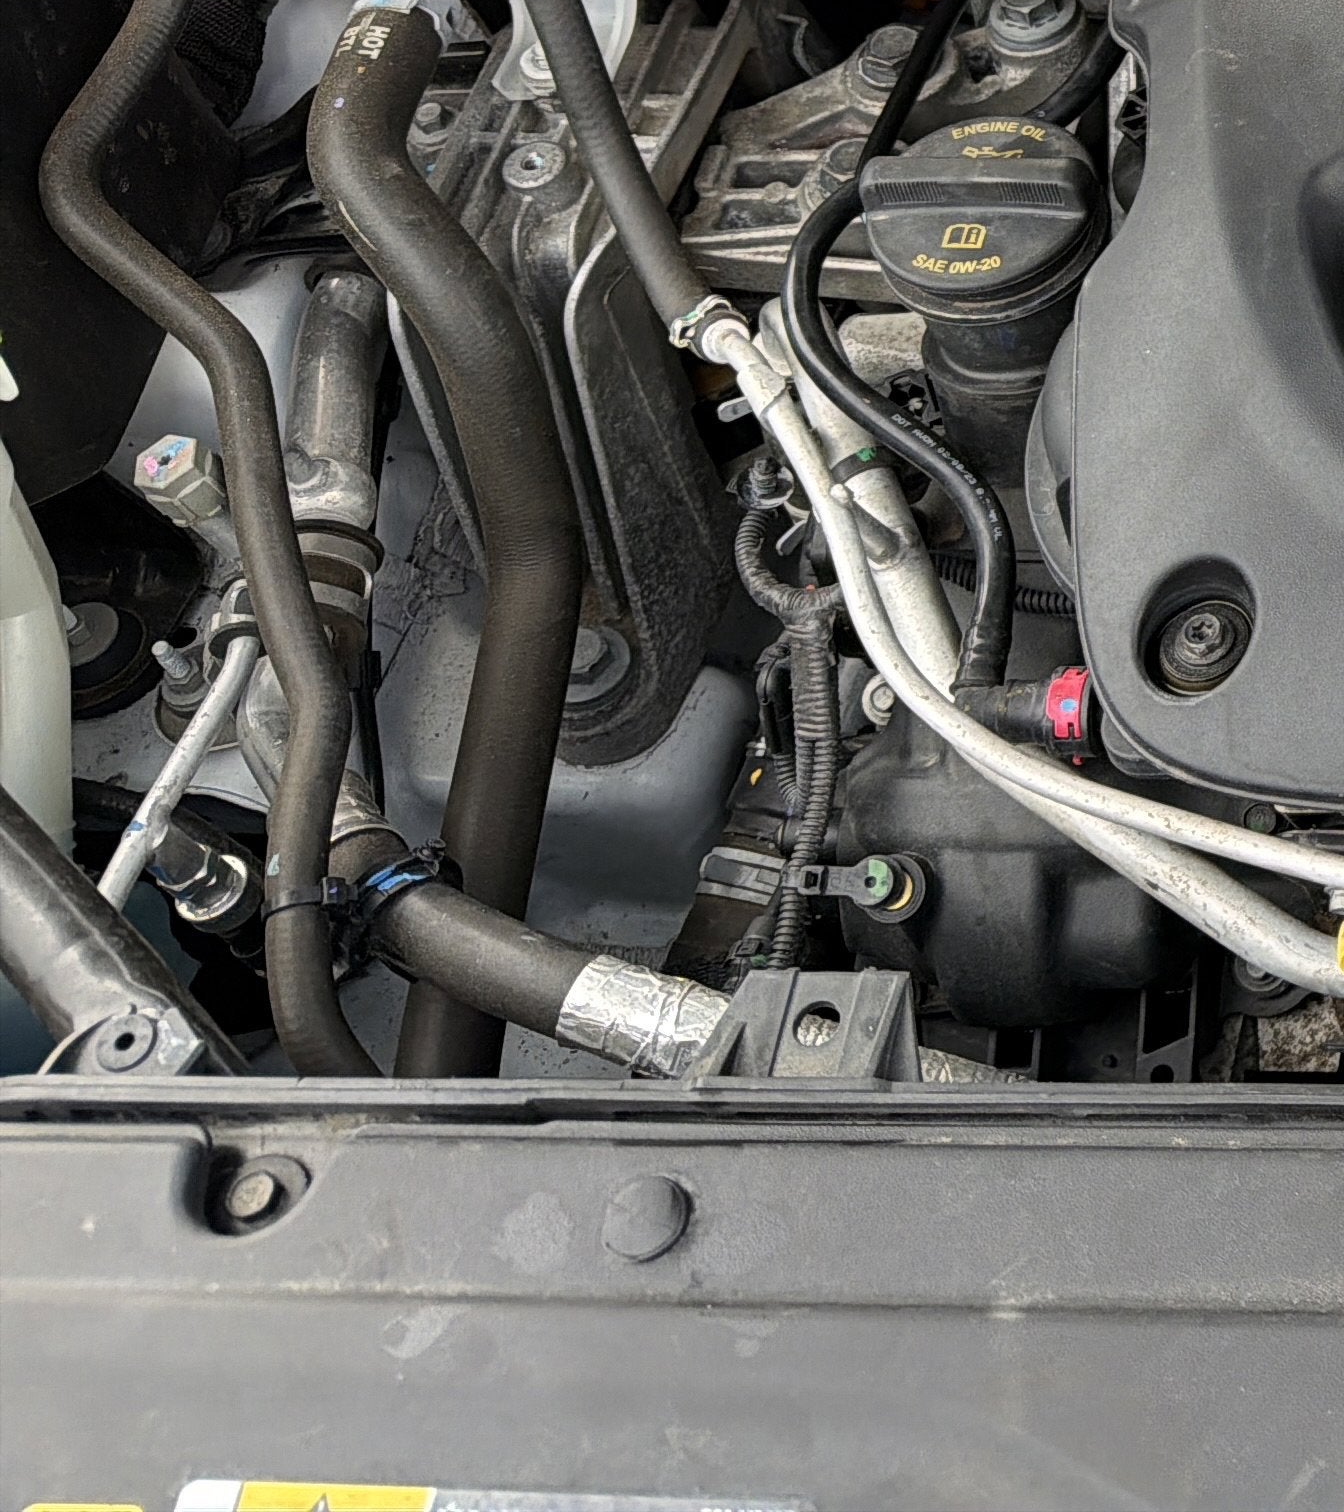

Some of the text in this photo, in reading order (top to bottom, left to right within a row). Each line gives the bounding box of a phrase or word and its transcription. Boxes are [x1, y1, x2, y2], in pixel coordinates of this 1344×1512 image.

[358, 24, 392, 61] HOT
[952, 121, 1048, 142] ENGINE OIL
[912, 253, 1002, 274] SAE 0W-20
